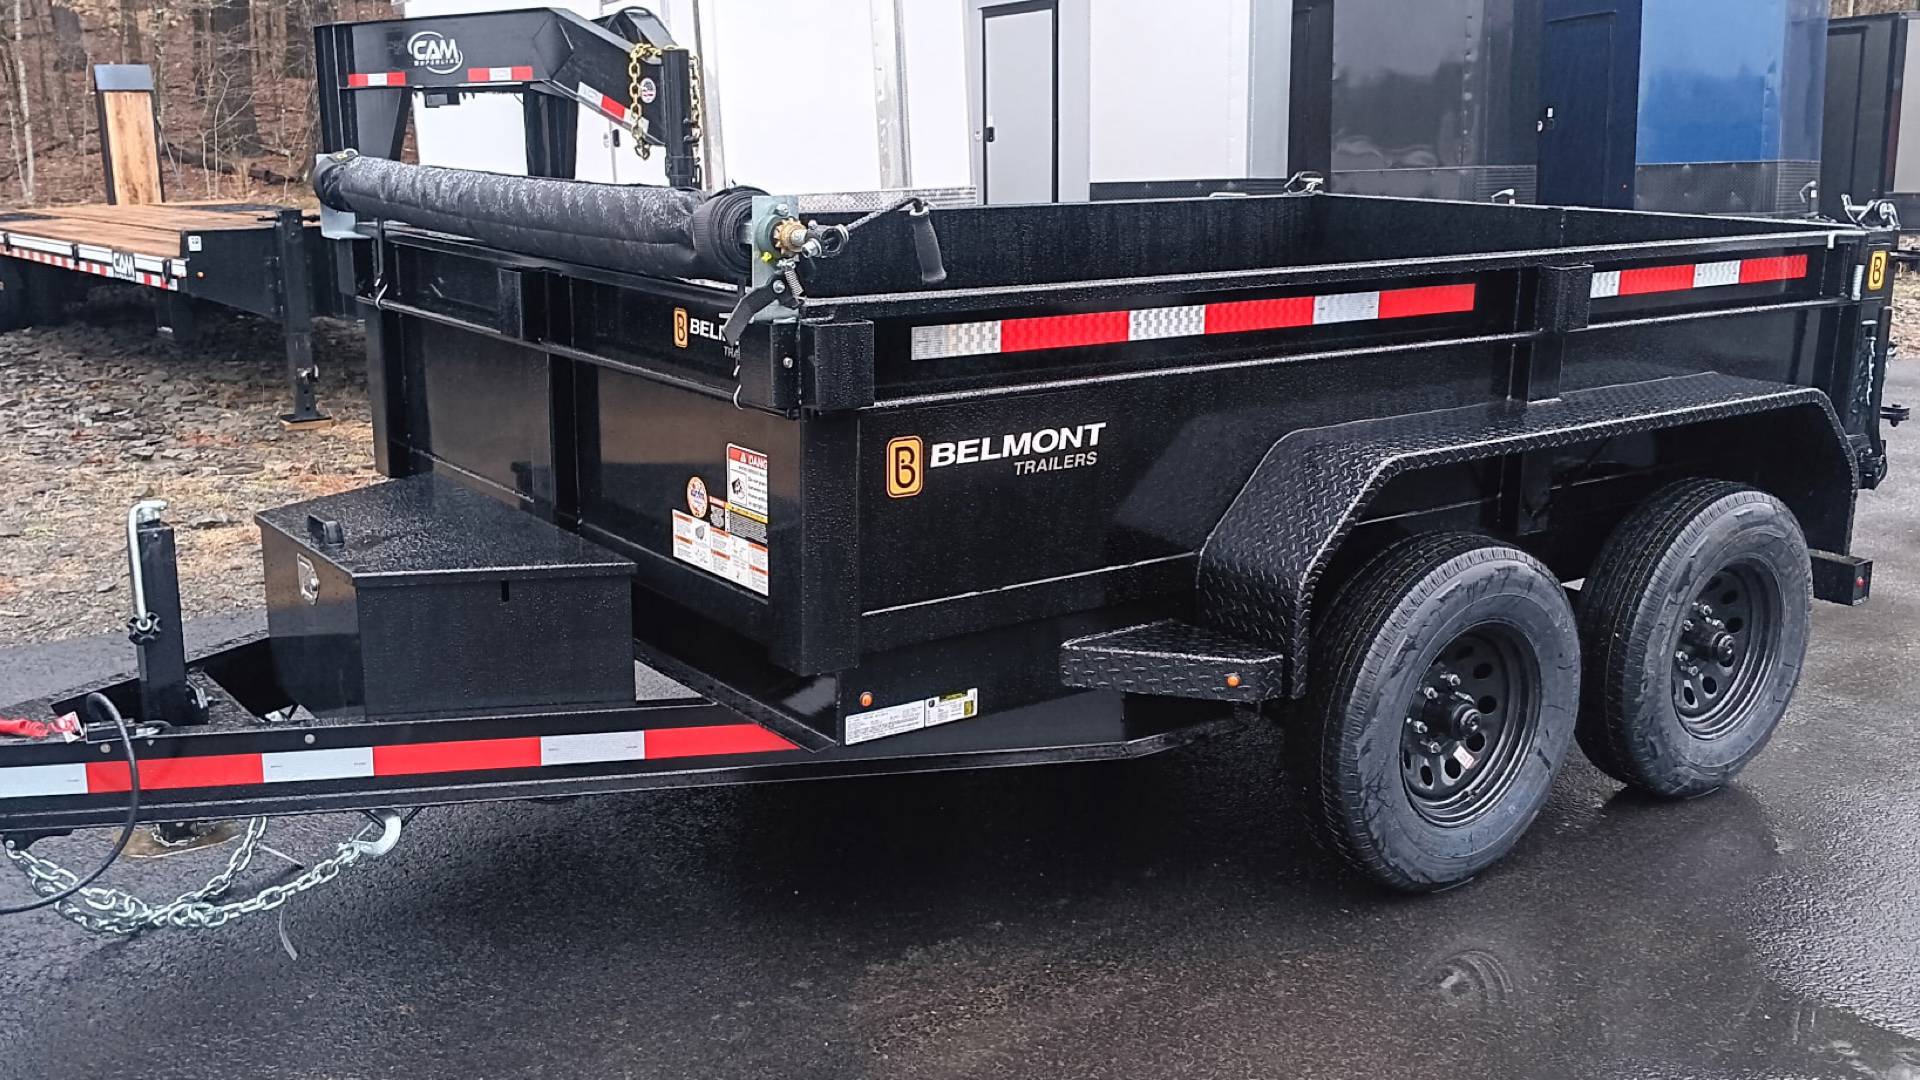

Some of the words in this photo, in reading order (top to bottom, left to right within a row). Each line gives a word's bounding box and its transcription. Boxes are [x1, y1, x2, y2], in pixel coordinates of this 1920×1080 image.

[413, 38, 459, 61] CAM
[113, 251, 136, 278] CAM
[930, 422, 1107, 468] BELMONT
[1014, 451, 1098, 476] TRAILERS
